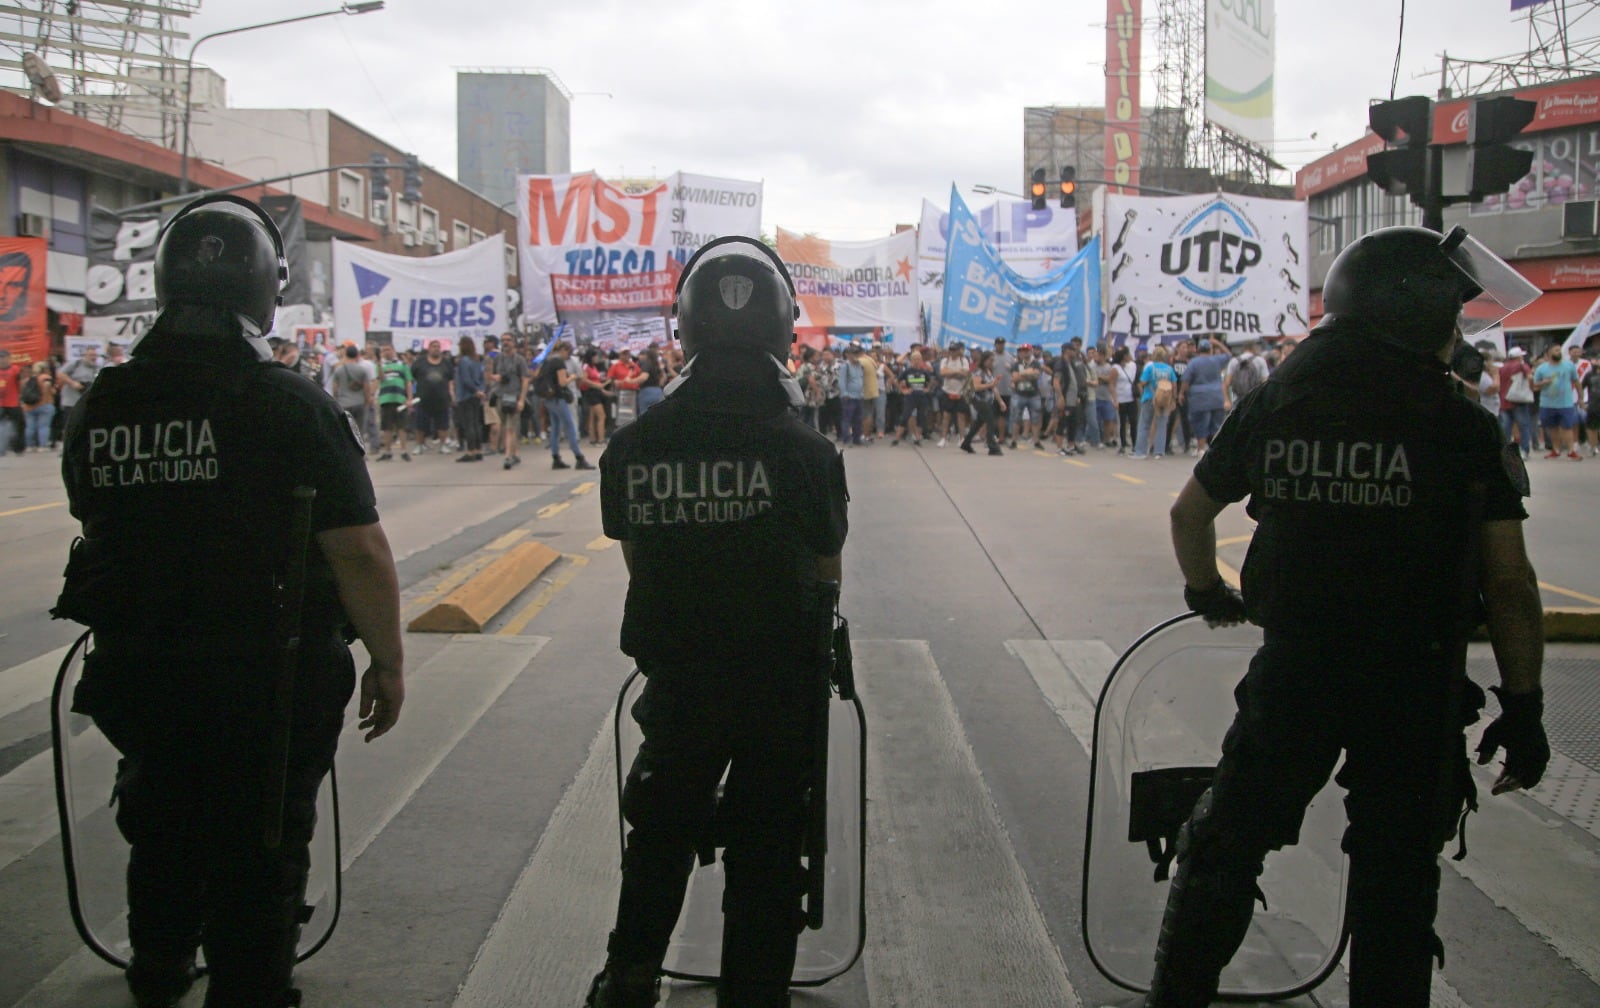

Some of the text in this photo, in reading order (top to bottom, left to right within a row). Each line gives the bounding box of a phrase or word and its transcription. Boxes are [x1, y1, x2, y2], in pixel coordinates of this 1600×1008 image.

[528, 174, 669, 246] MST
[1160, 229, 1262, 276] UTEP
[555, 273, 672, 291] FRENTE POPULAR
[785, 262, 893, 283] COORDINADORA
[797, 279, 909, 298] CAMBIO SOCIAL
[389, 294, 496, 328] LIBRES
[959, 284, 1069, 333] DE PIE
[1149, 308, 1264, 334] ESCOBAR
[89, 418, 217, 463] POLICIA
[91, 457, 218, 488] DE LA CIUDAD
[1264, 439, 1412, 482] POLICIA
[627, 460, 772, 500] POLICIA
[1264, 477, 1412, 507] DE LA CIUDAD
[629, 503, 655, 525] DE
[661, 502, 689, 524] LA
